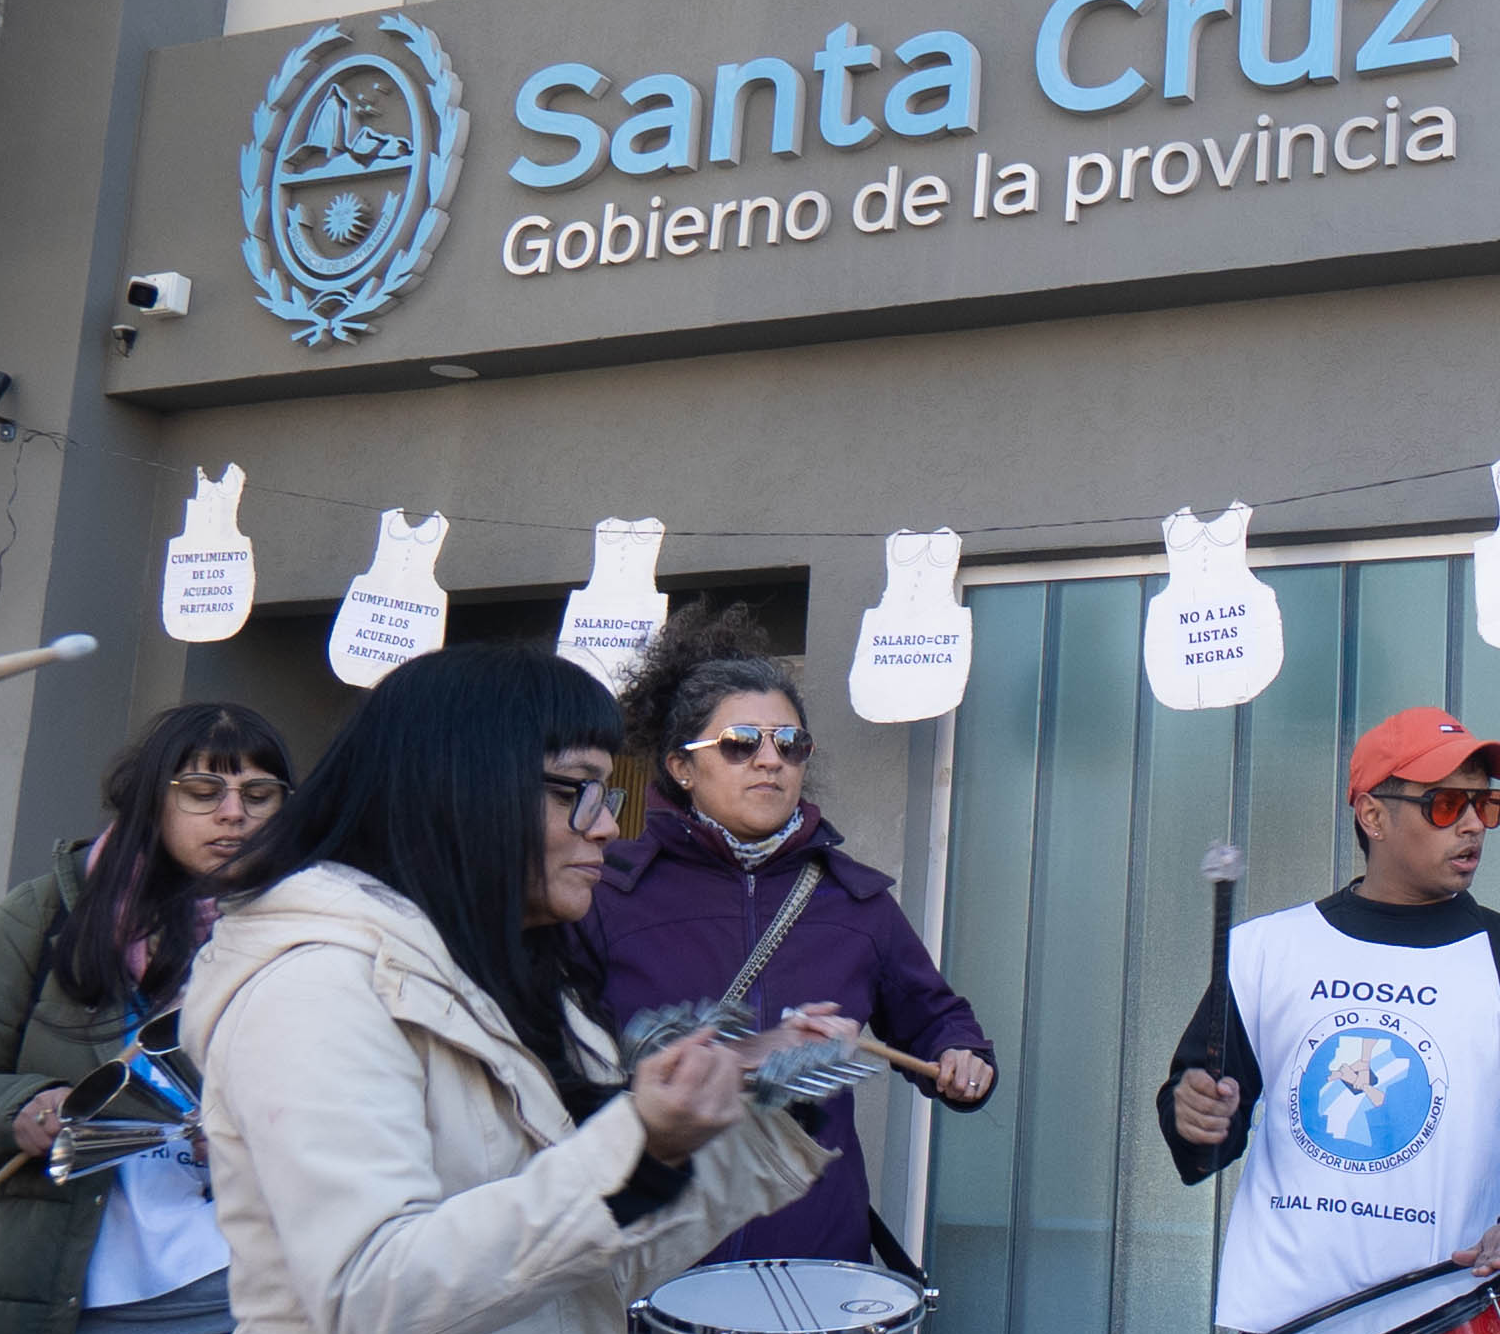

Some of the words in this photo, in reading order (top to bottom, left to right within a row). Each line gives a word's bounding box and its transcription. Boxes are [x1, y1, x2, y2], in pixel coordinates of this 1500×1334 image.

[507, 21, 982, 194] Santa
[502, 196, 832, 276] Gobierno
[852, 165, 950, 233] de
[973, 152, 1040, 221] la
[1065, 96, 1457, 224] provincia
[171, 551, 248, 564] CUMPLIMIENTO
[192, 570, 205, 580] DE
[207, 569, 225, 579] LOS
[183, 586, 233, 597] ACUERDOS
[180, 603, 234, 613] PARITARIOS
[351, 591, 440, 617] CUMPLIMIENTO
[370, 613, 386, 624] DE
[388, 616, 410, 629] LOS
[1180, 611, 1200, 624] NO
[1205, 609, 1215, 620] A
[1219, 604, 1246, 619] LAS
[355, 628, 415, 649] ACUERDOS
[574, 635, 646, 648] PATAGÓNIC
[873, 634, 959, 646] SALARIO=CBT
[1188, 627, 1238, 644] LISTAS
[874, 651, 952, 665] PATAGÓNICA
[1185, 646, 1244, 665] NEGRAS
[1310, 979, 1438, 1006] ADOSAC
[1290, 1087, 1299, 1129] TODOS
[1421, 1095, 1444, 1139] MEJOR
[1293, 1128, 1320, 1161] JUNTOS
[1319, 1151, 1346, 1169] POR
[1369, 1137, 1425, 1172] EDUCACION
[1343, 1159, 1366, 1172] UNA
[1316, 1197, 1346, 1213] RIO
[1351, 1201, 1436, 1225] GALLEGOS
